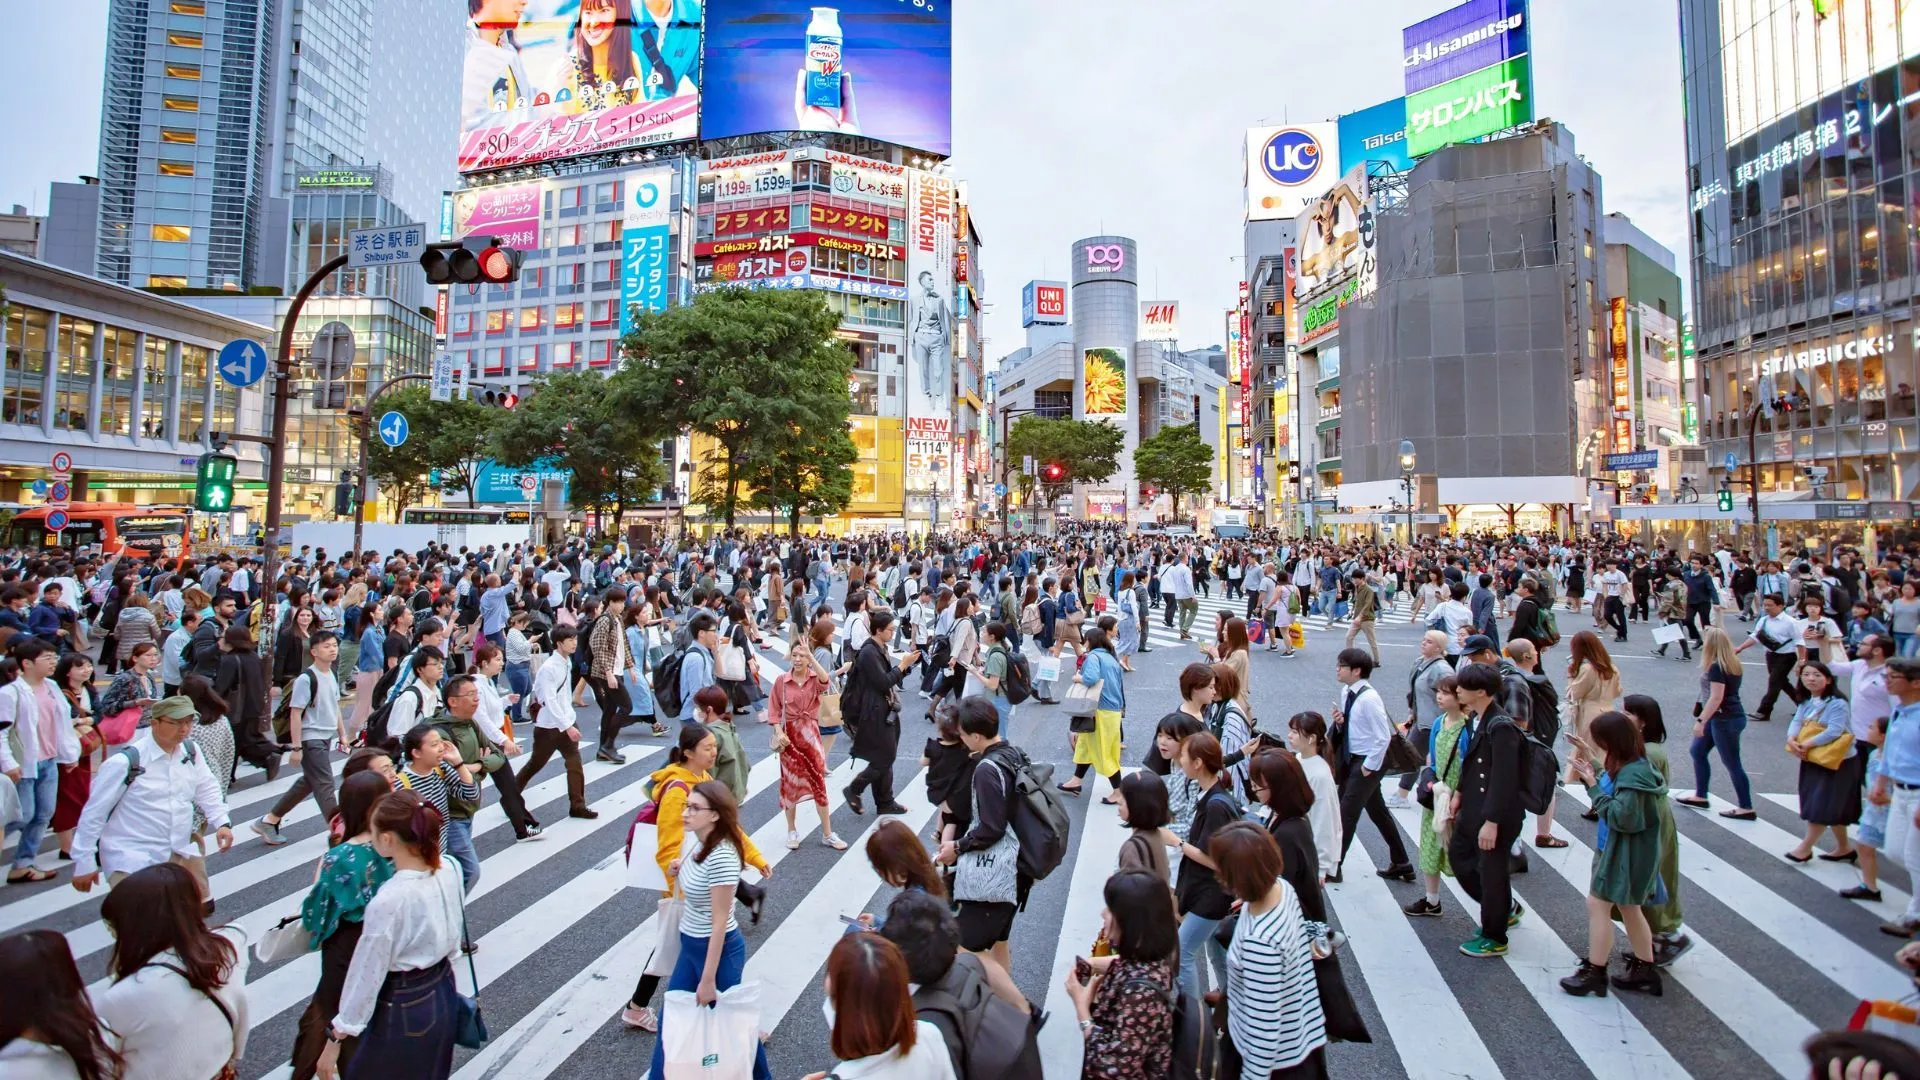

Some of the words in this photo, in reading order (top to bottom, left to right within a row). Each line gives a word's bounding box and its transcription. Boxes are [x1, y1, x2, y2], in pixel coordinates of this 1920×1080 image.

[1406, 13, 1523, 65] Hisamitsu
[822, 59, 839, 75] W
[1410, 79, 1522, 134] サロンパス
[609, 113, 645, 135] 5.19
[649, 111, 674, 126] SUN
[708, 151, 787, 170] しゃぶしゃぶバイキング
[824, 150, 904, 176] しゃぶしゃぶバイキング
[1268, 142, 1317, 172] UC
[299, 175, 338, 185] MARK
[339, 175, 374, 185] CITY
[700, 182, 714, 194] 9F
[754, 175, 791, 194] 1,599円
[857, 176, 903, 198] しゃぶ葉
[493, 191, 537, 206] 品川スキン
[935, 177, 950, 224] EXILE
[493, 205, 531, 219] クリニック
[716, 208, 788, 231] プライス
[811, 206, 886, 233] コンタクト
[919, 174, 935, 253] SHOKICHI
[355, 229, 420, 251] 渋谷駅前
[498, 230, 534, 246] 容外科
[759, 235, 795, 251] ガスト
[364, 252, 394, 263] Shibuya
[396, 250, 411, 260] Sta.
[864, 243, 899, 260] ガスト
[1085, 245, 1124, 272] 109
[697, 265, 713, 277] 7F
[716, 262, 736, 272] Café
[737, 257, 782, 278] ガスト
[842, 281, 906, 297] 英会話イーオン
[1040, 290, 1060, 300] UNI
[1040, 301, 1061, 312] QLO
[1145, 305, 1175, 325] H&M
[909, 417, 948, 431] NEW
[908, 431, 949, 441] ALBUM
